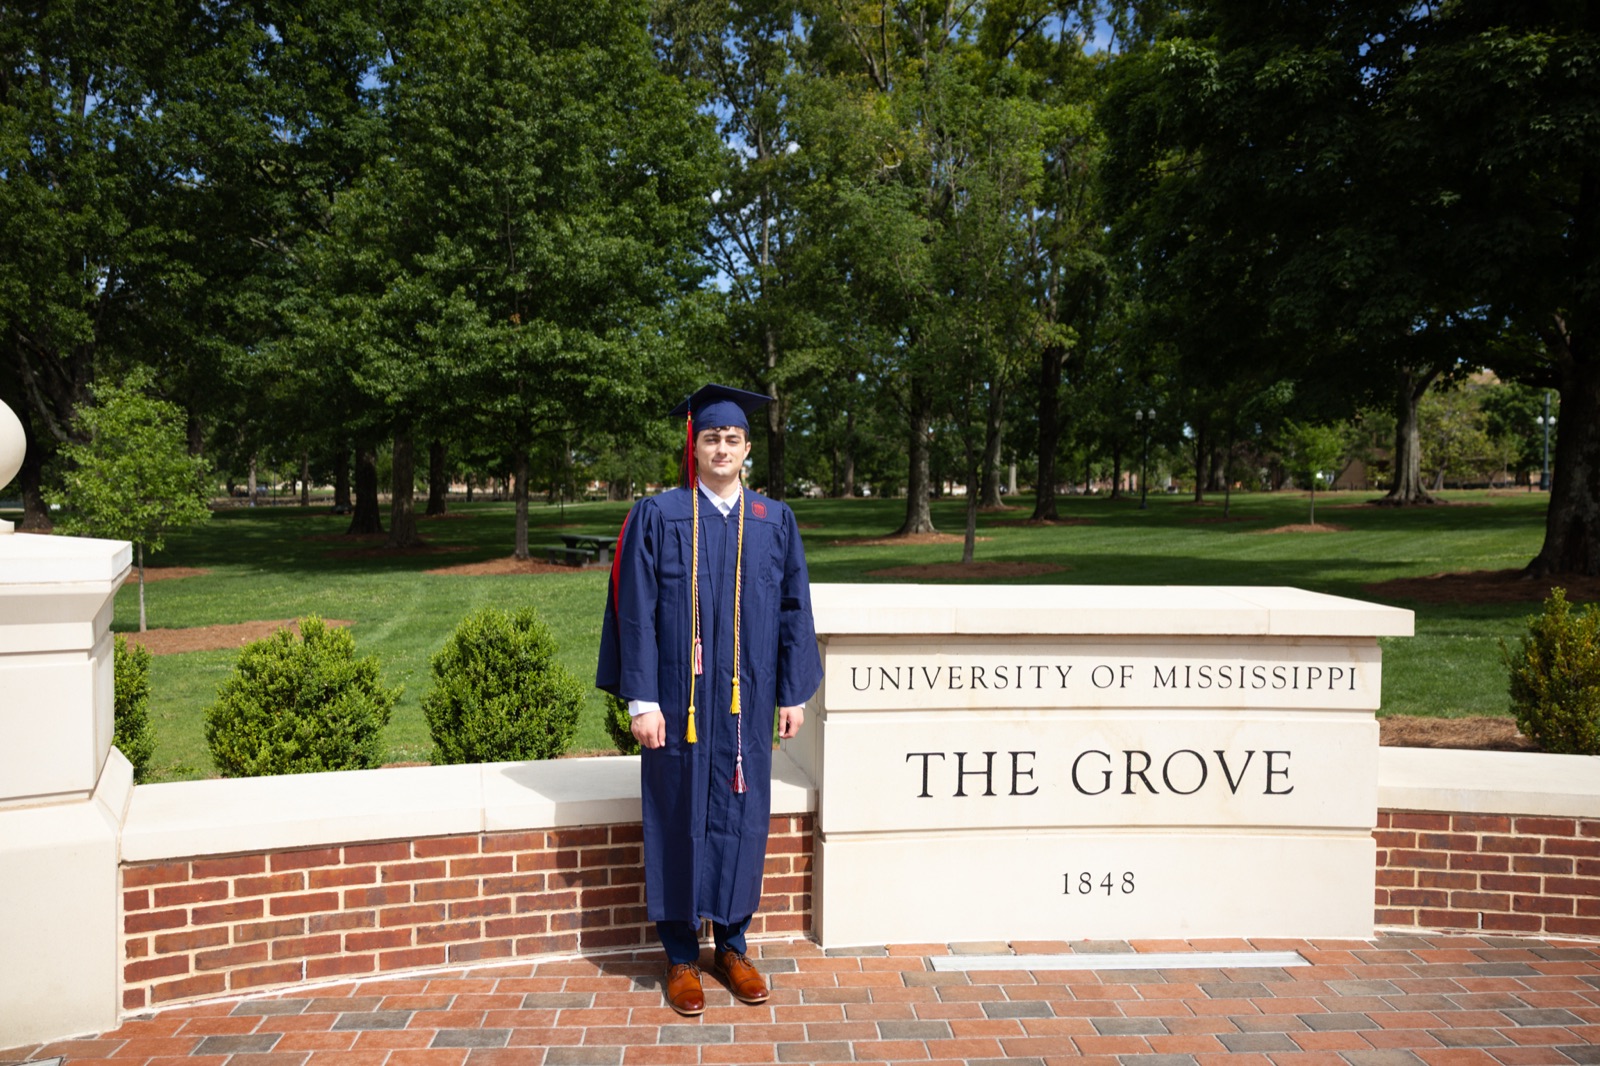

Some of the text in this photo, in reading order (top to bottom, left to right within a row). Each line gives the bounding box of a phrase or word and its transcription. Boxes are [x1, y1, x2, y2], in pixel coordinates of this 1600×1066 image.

[851, 665, 1357, 692] UNIVERSITY OF MISSISSIPPI
[906, 749, 1294, 799] THE GROVE
[1062, 871, 1136, 897] 1848
